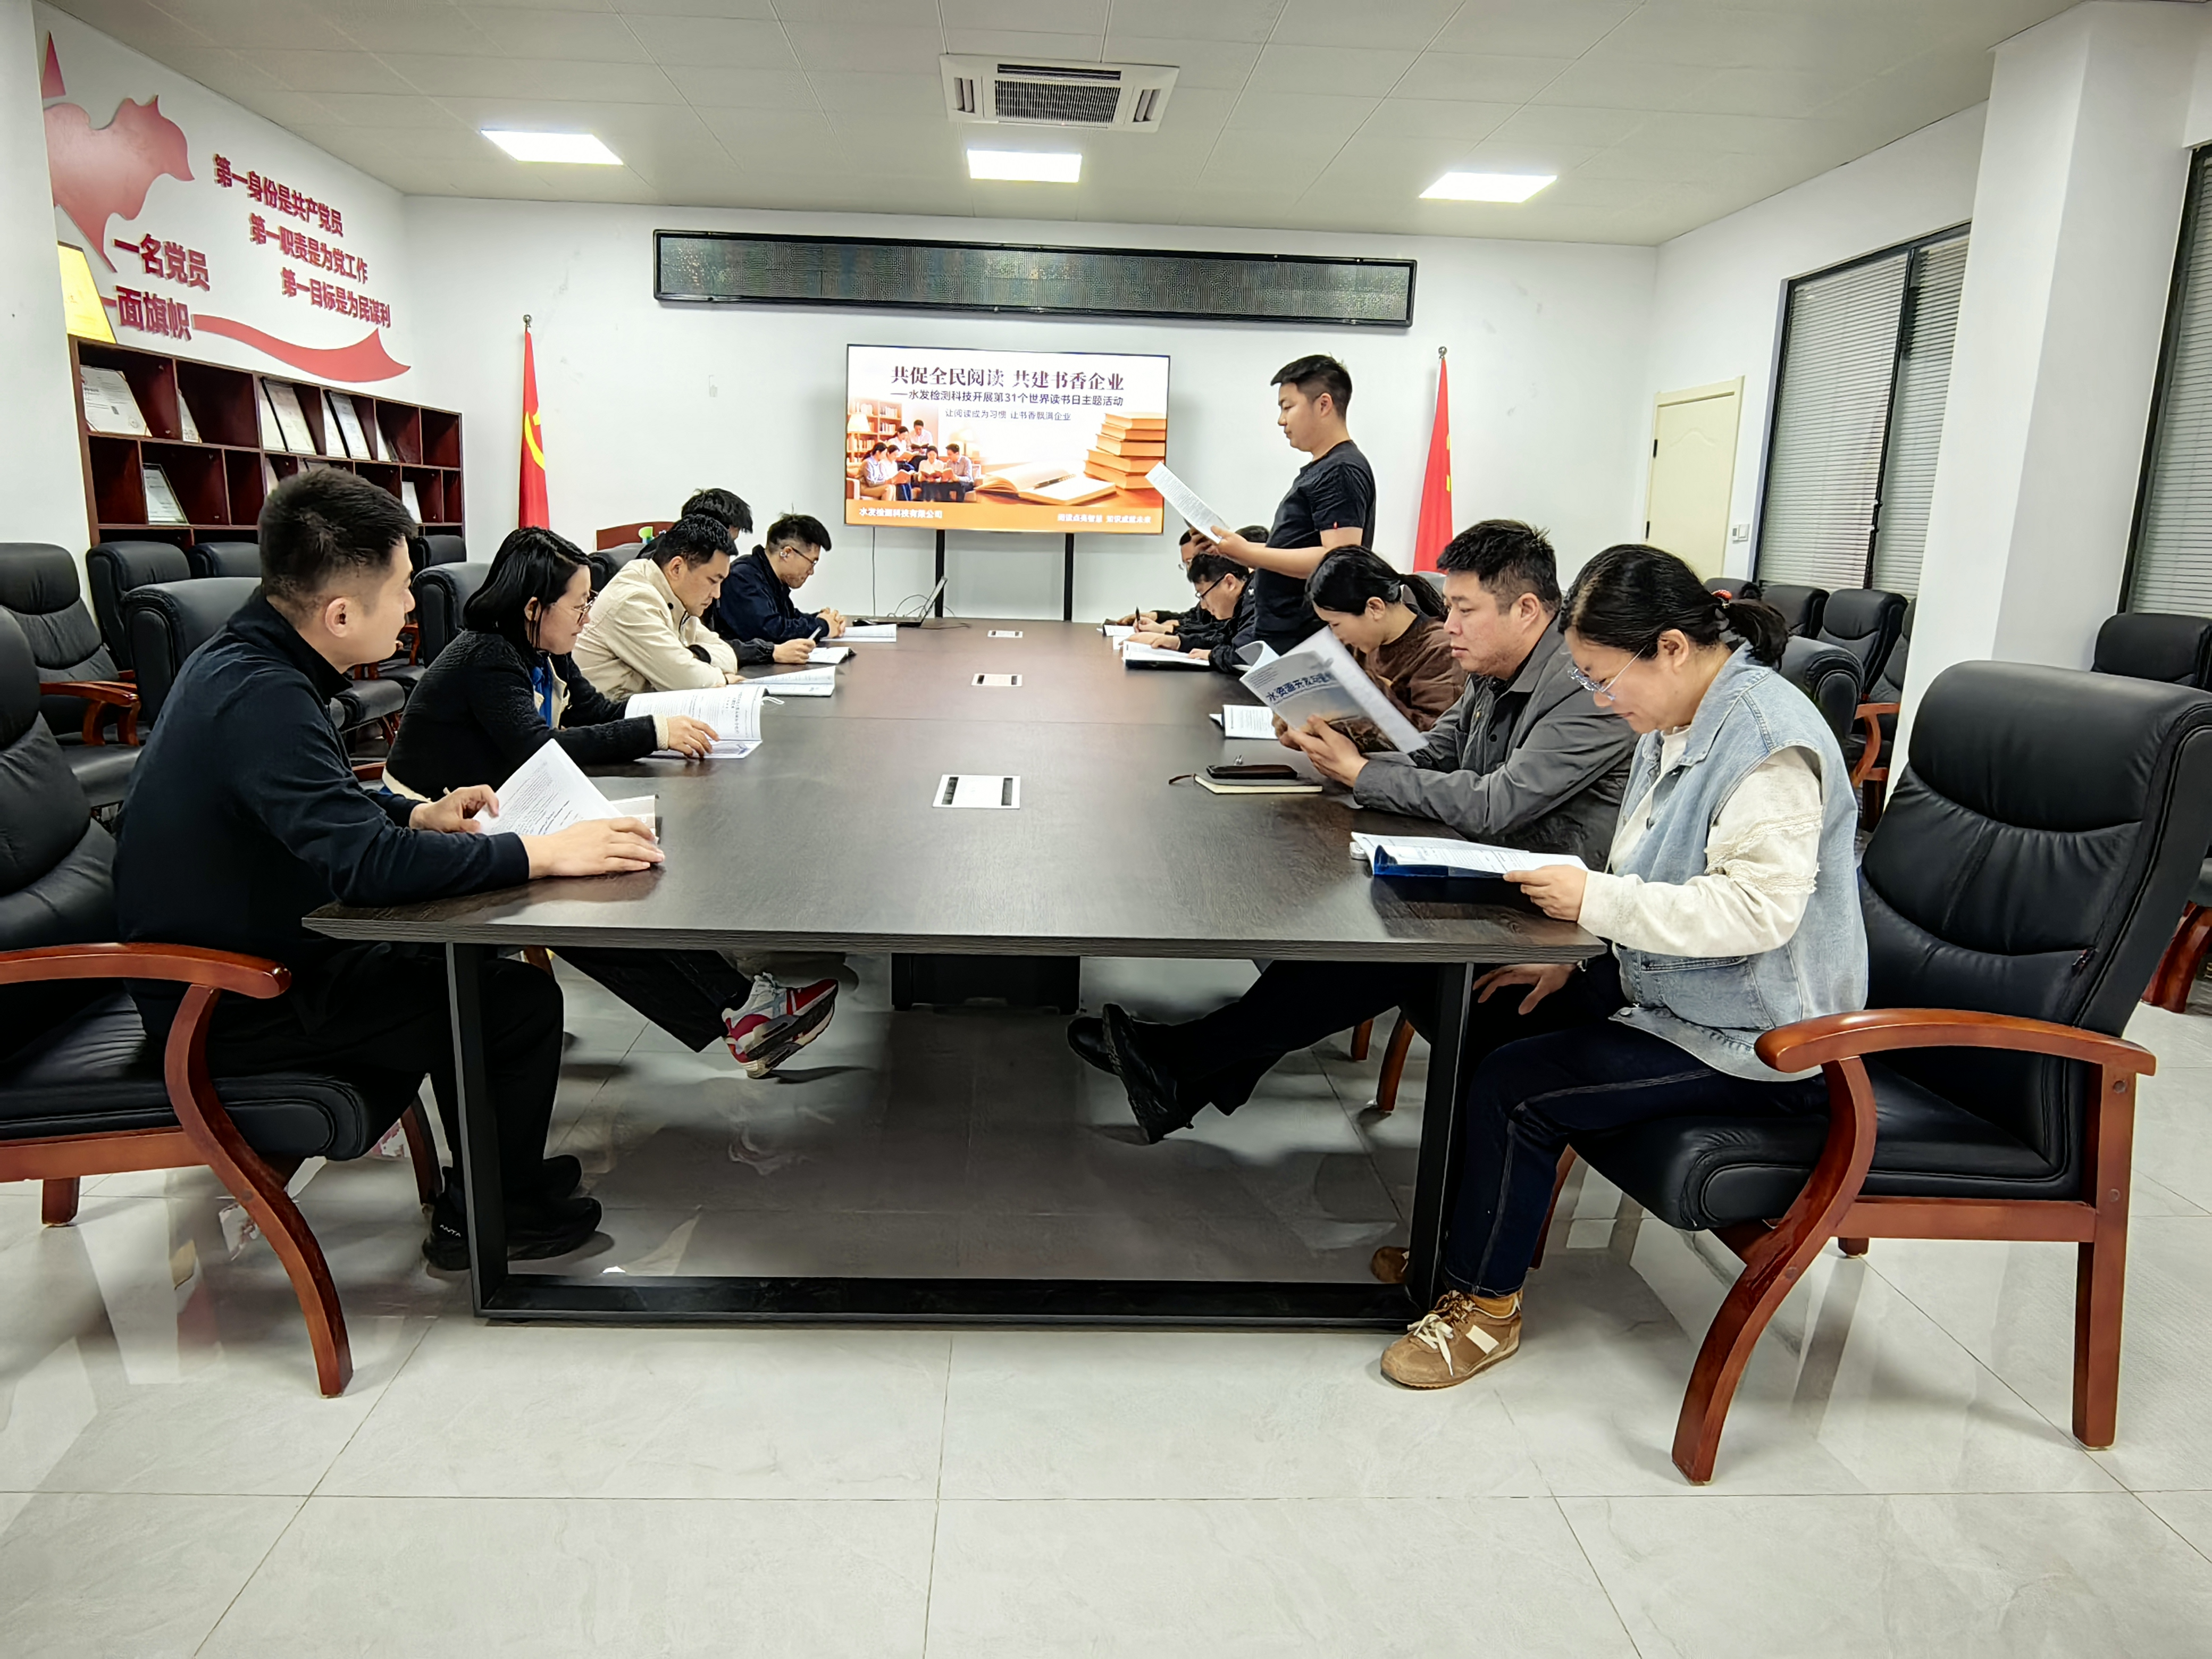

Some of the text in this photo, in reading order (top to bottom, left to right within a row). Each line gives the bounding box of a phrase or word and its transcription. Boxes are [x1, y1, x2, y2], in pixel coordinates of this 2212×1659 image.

[213, 154, 343, 238] 第一身份是共产党员
[112, 233, 210, 291] 一名党员
[249, 213, 368, 284] 第一职责是为党工作
[281, 267, 391, 328] 第一目标是为民谋利
[891, 366, 1124, 390] 共促全民阅读 共建书香企业
[945, 408, 1007, 419] 让阅读成为习惯
[859, 507, 943, 518] 水发检测科技有限公司
